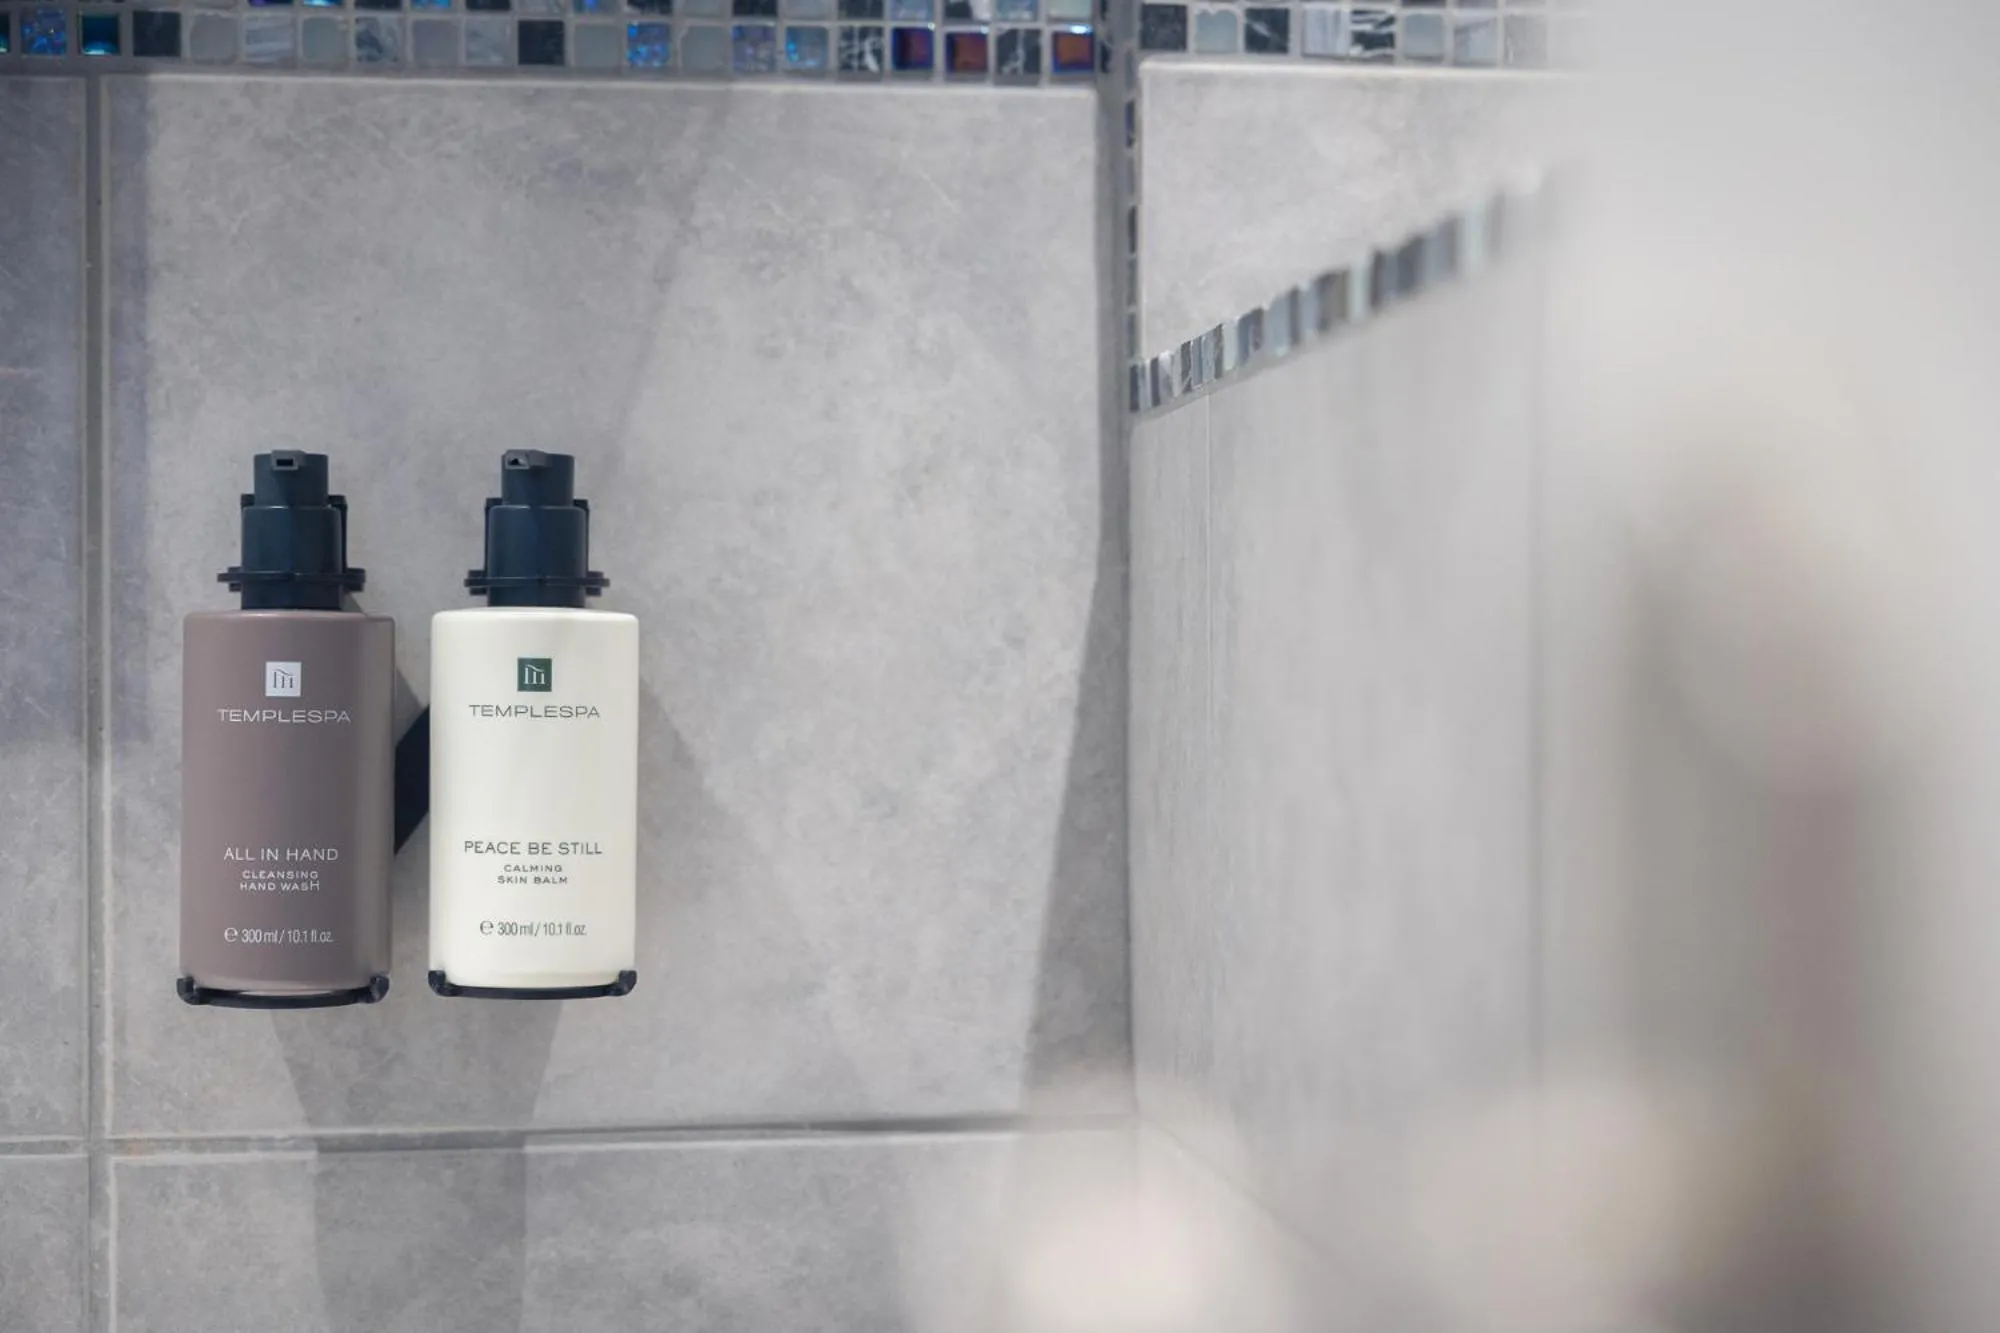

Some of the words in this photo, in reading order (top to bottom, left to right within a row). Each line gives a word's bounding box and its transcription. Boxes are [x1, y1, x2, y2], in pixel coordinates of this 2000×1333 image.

[217, 708, 351, 723] TEMPLESPA
[469, 704, 600, 719] TEMPLESPA
[223, 847, 256, 861] ALL
[260, 847, 279, 861] IN
[286, 847, 338, 861] HAND
[464, 841, 521, 855] PEACE
[528, 842, 552, 855] BE
[558, 842, 602, 855] STILL
[503, 864, 563, 873] CALMING
[242, 870, 318, 880] CLEANSING
[497, 875, 528, 885] SKIN
[533, 876, 568, 885] BALM
[240, 882, 276, 891] HAND
[280, 880, 320, 891] WASH
